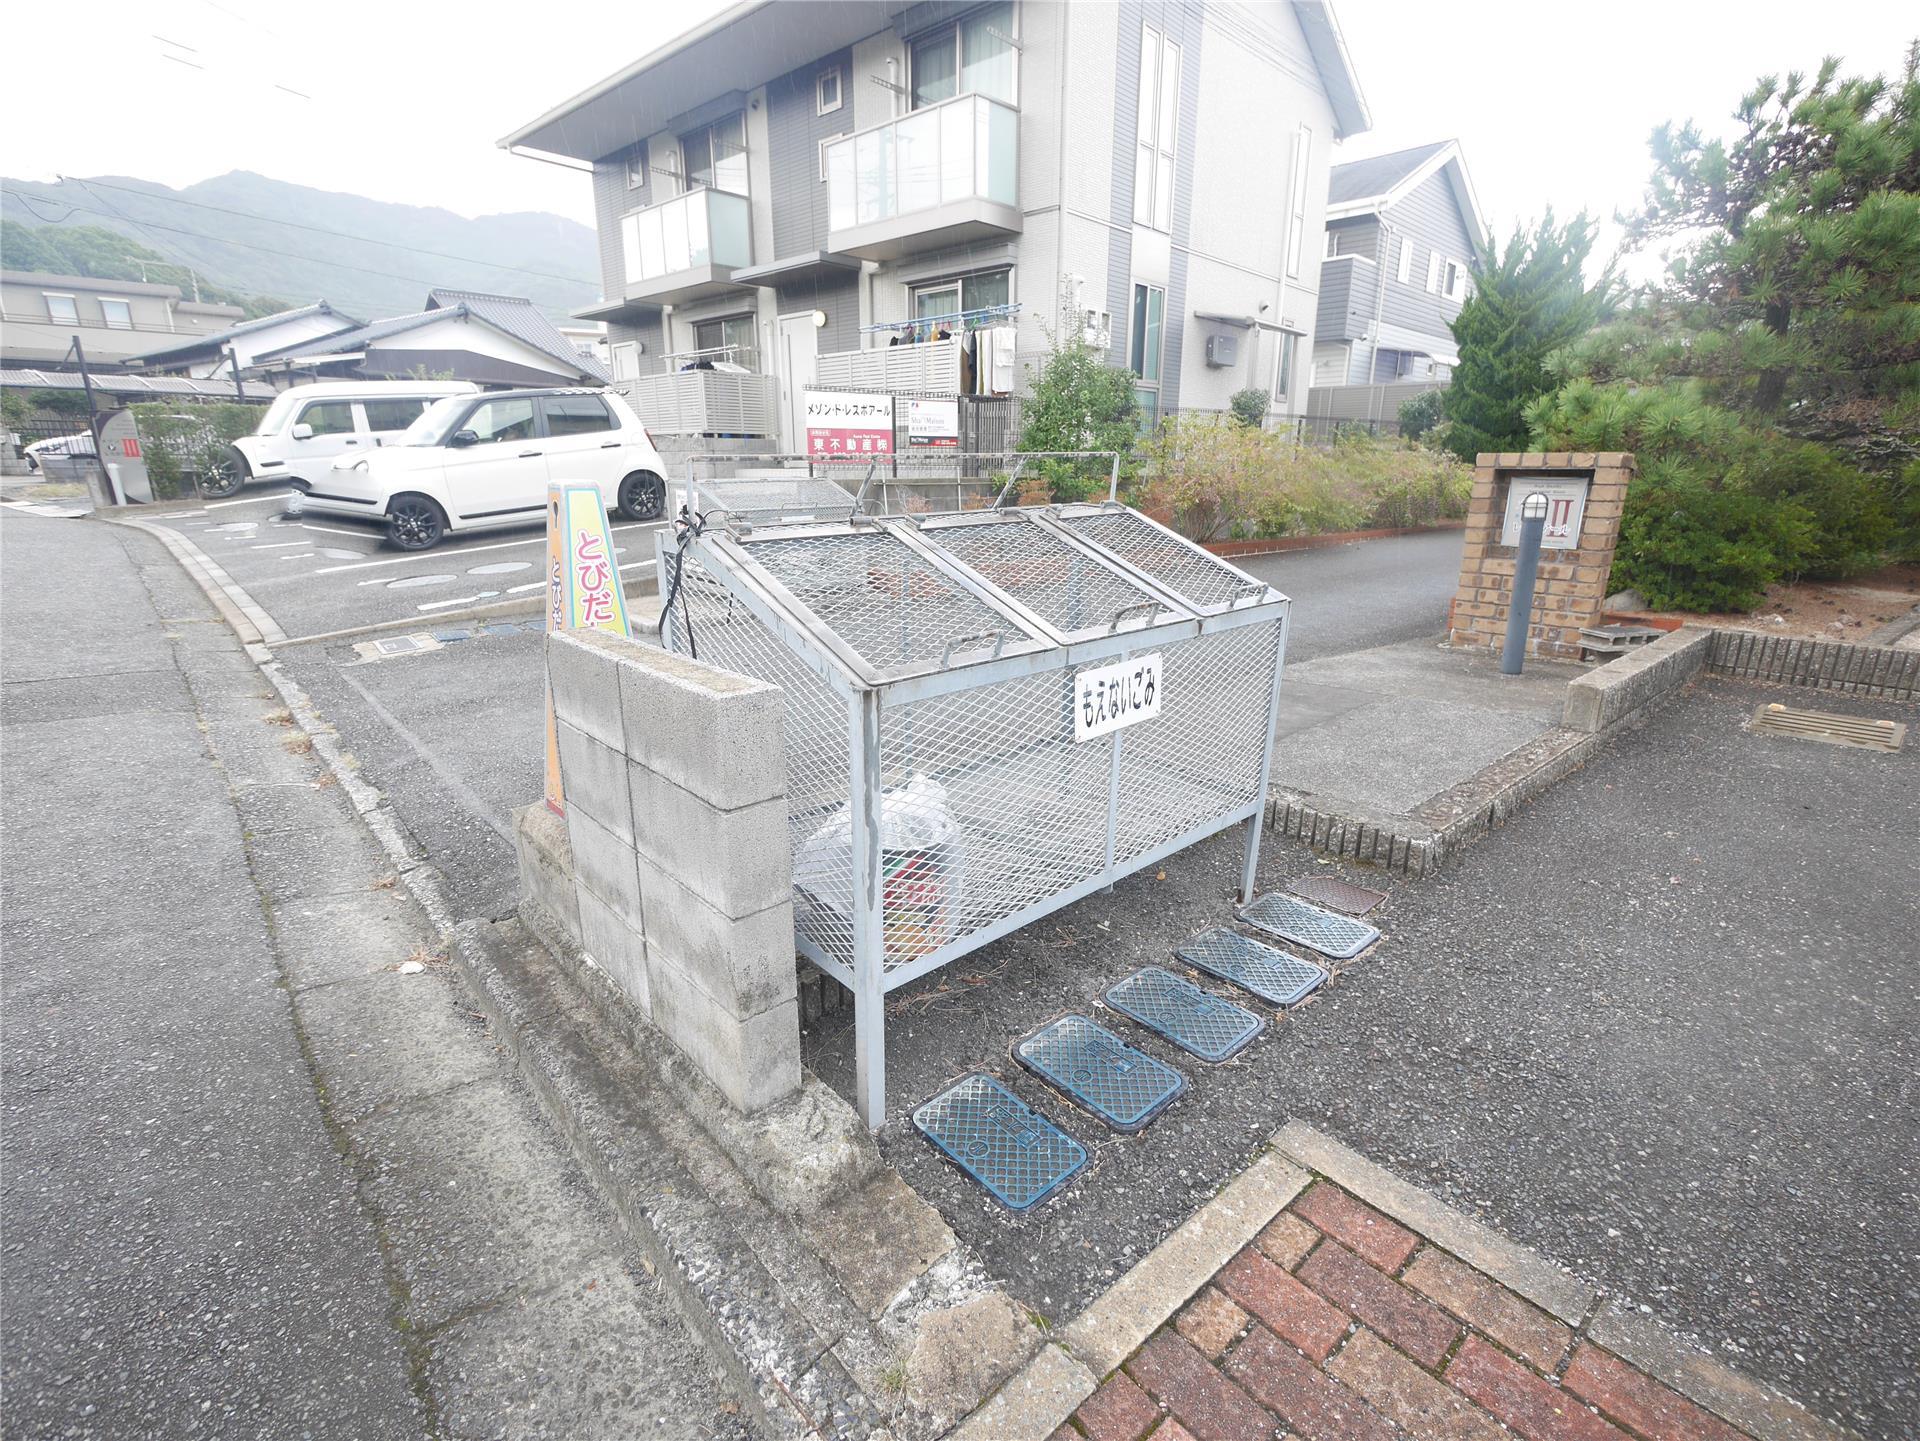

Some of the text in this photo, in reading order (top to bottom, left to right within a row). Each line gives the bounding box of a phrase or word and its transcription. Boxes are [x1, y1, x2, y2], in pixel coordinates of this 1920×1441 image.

[1083, 666, 1155, 728] もえないごみ
